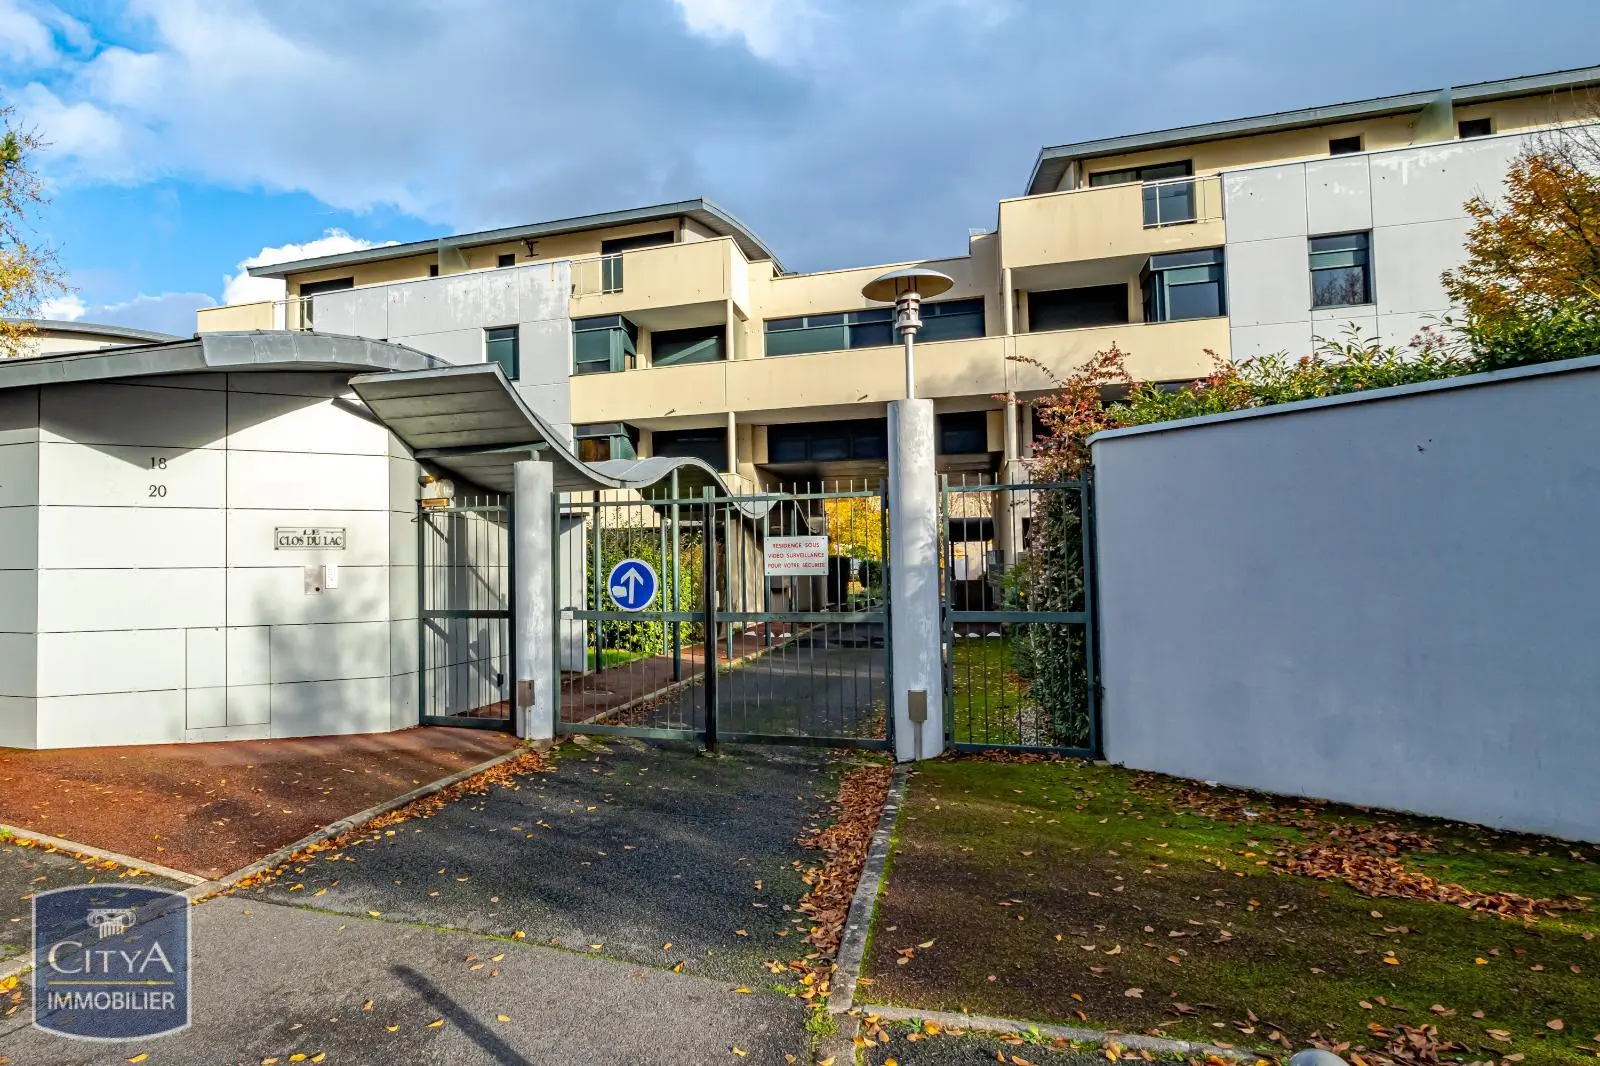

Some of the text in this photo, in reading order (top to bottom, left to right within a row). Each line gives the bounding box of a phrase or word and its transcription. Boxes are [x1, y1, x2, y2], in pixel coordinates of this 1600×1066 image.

[151, 457, 167, 470] 18
[149, 485, 167, 498] 20
[279, 536, 342, 546] CLOS DU LAC
